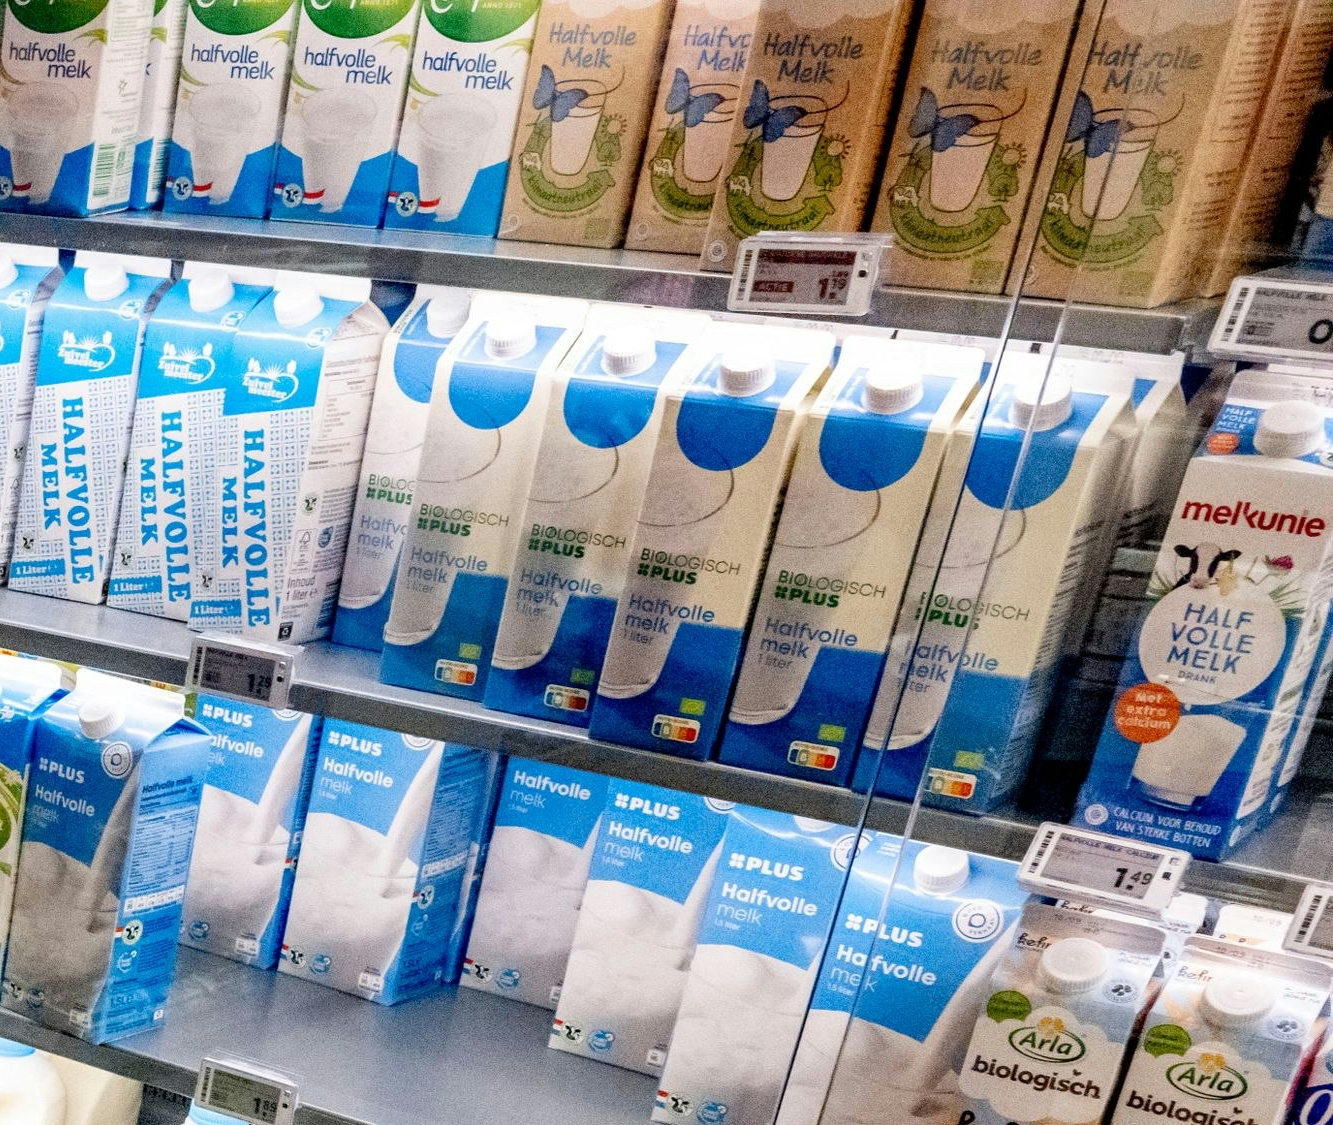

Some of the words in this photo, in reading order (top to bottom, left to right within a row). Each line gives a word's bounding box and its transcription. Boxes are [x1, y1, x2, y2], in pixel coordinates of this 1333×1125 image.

[549, 22, 638, 47] Halfvolle
[764, 32, 864, 60] Halfvolle
[9, 42, 77, 64] halfvolle
[190, 44, 259, 65] halfvolle
[304, 46, 377, 69] halfvolle
[422, 52, 497, 73] halfvolle
[561, 46, 611, 70] Melk
[932, 40, 1045, 67] Halfvolle
[47, 61, 92, 80] melk
[230, 62, 275, 81] melk
[345, 65, 393, 85] melk
[464, 70, 514, 91] melk
[777, 59, 835, 84] Melk
[946, 66, 1010, 92] Melk
[1225, 407, 1252, 416] HALF
[140, 457, 159, 547] MELK
[221, 476, 240, 569] MELK
[419, 503, 510, 528] BIOLOGISCH
[1181, 500, 1326, 538] melkunie
[243, 429, 270, 628] HALFVOLLE
[531, 523, 627, 550] BIOLOGISCH
[411, 547, 488, 572] Halfvolle
[640, 548, 741, 576] BIOLOGISCH
[407, 565, 447, 585] melk
[520, 568, 603, 595] Halfvolle
[778, 569, 887, 599] BIOLOGISCH
[631, 593, 716, 623] Halfvolle
[1184, 602, 1255, 628] HALF
[625, 613, 669, 635] melk
[760, 636, 808, 659] melk
[1171, 623, 1254, 654] VOLLE
[1167, 647, 1239, 675] MELK
[1177, 670, 1217, 685] DRANK
[1117, 717, 1171, 729] calcium
[1126, 707, 1167, 717] extra
[320, 773, 353, 796] melk
[510, 787, 547, 809] melk
[1114, 807, 1153, 823] CALCIUM
[1158, 816, 1181, 828] VOOR
[1184, 821, 1222, 835] BEHOUD
[1115, 822, 1134, 833] VAN
[1137, 826, 1170, 840] STERKE
[1173, 833, 1212, 848] BOTTEN
[603, 840, 644, 864] melk
[1115, 867, 1154, 893] 1.49
[717, 901, 762, 927] melk
[1019, 1030, 1073, 1057] Arla
[971, 1055, 1102, 1100] biologisch
[1178, 1066, 1235, 1094] Arla
